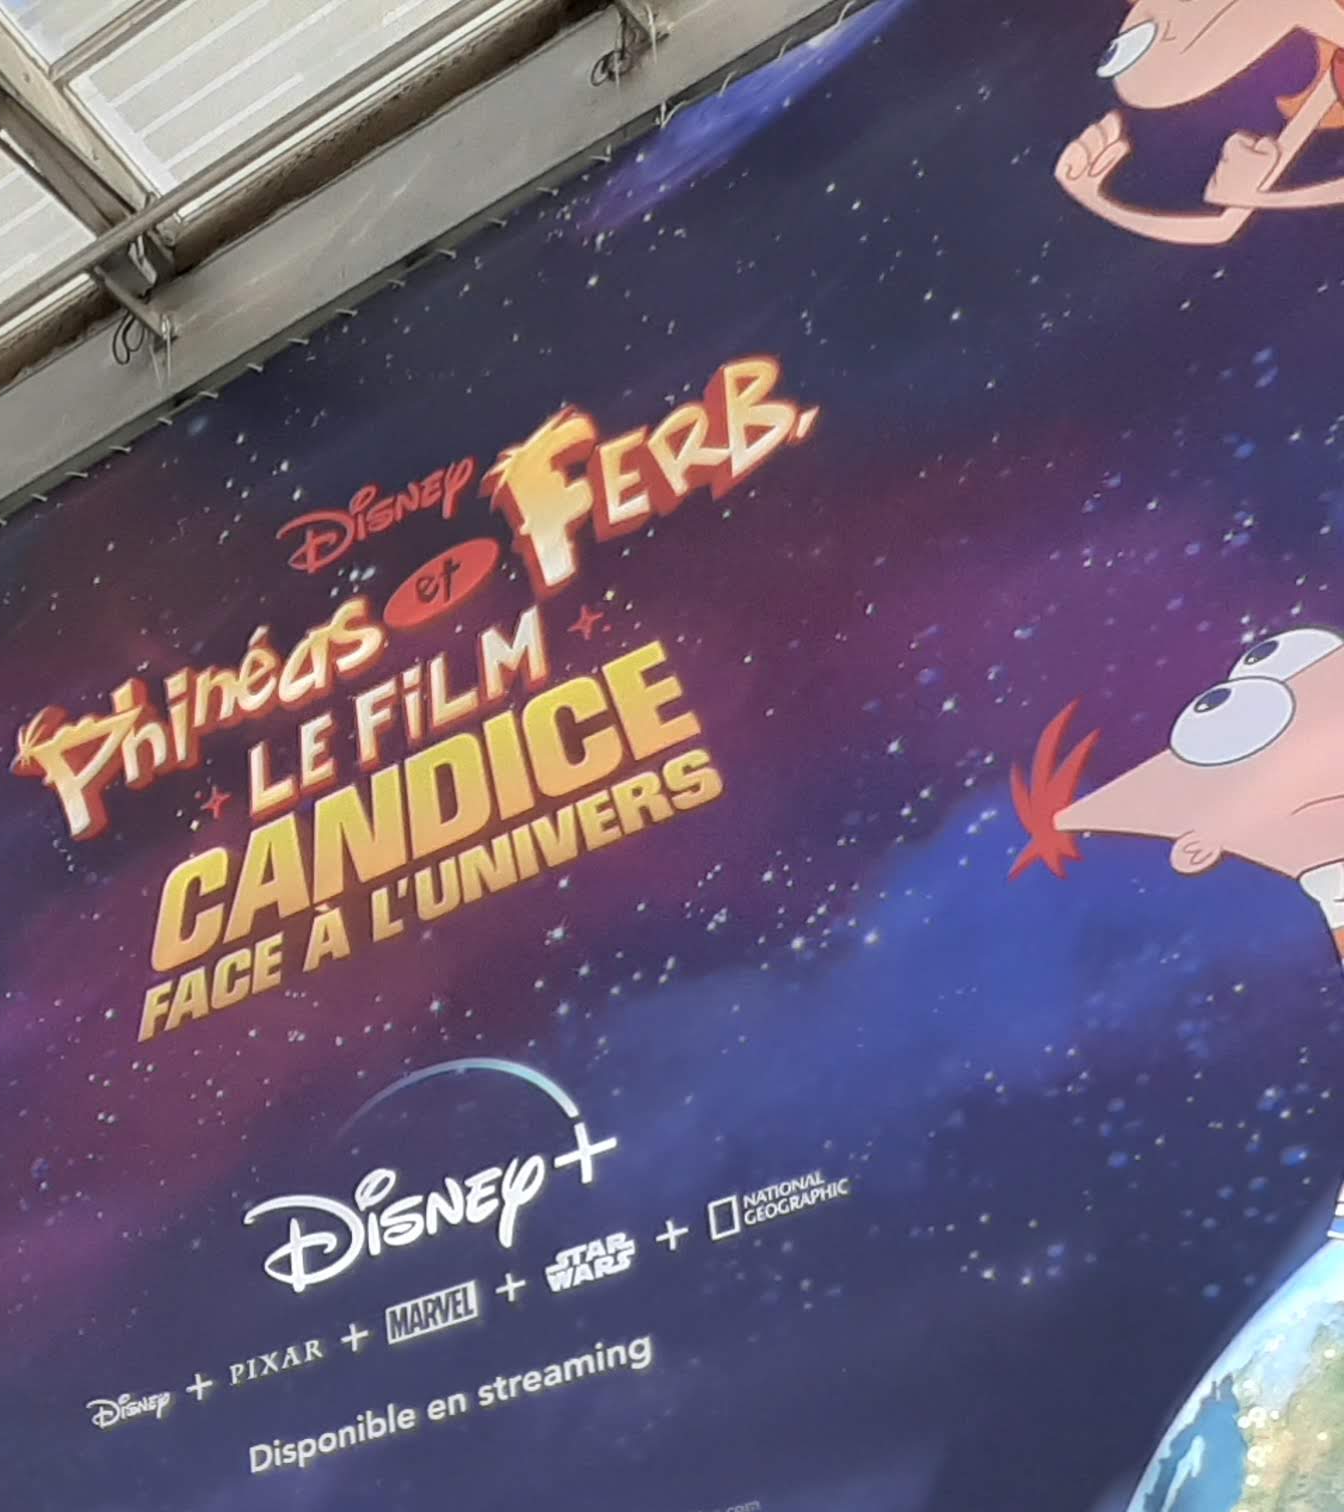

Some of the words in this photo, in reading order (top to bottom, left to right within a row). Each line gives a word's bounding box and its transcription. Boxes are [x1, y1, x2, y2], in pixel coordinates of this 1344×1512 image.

[416, 558, 463, 603] et
[151, 641, 702, 973] CANDICE
[249, 720, 335, 820] LE
[138, 931, 283, 1042] FACE
[302, 903, 350, 972] À
[368, 747, 725, 939] L'UNIVERS
[743, 1171, 825, 1209] NATIONAL
[744, 1178, 849, 1226] GEOGRAPHIC
[545, 1250, 636, 1292] WARS
[555, 1231, 635, 1271] STAR
[229, 1339, 323, 1385] PIXAR
[389, 1284, 476, 1341] MARVEL
[249, 1404, 415, 1473] Disponible
[426, 1391, 467, 1422] en
[477, 1335, 653, 1406] streaming
